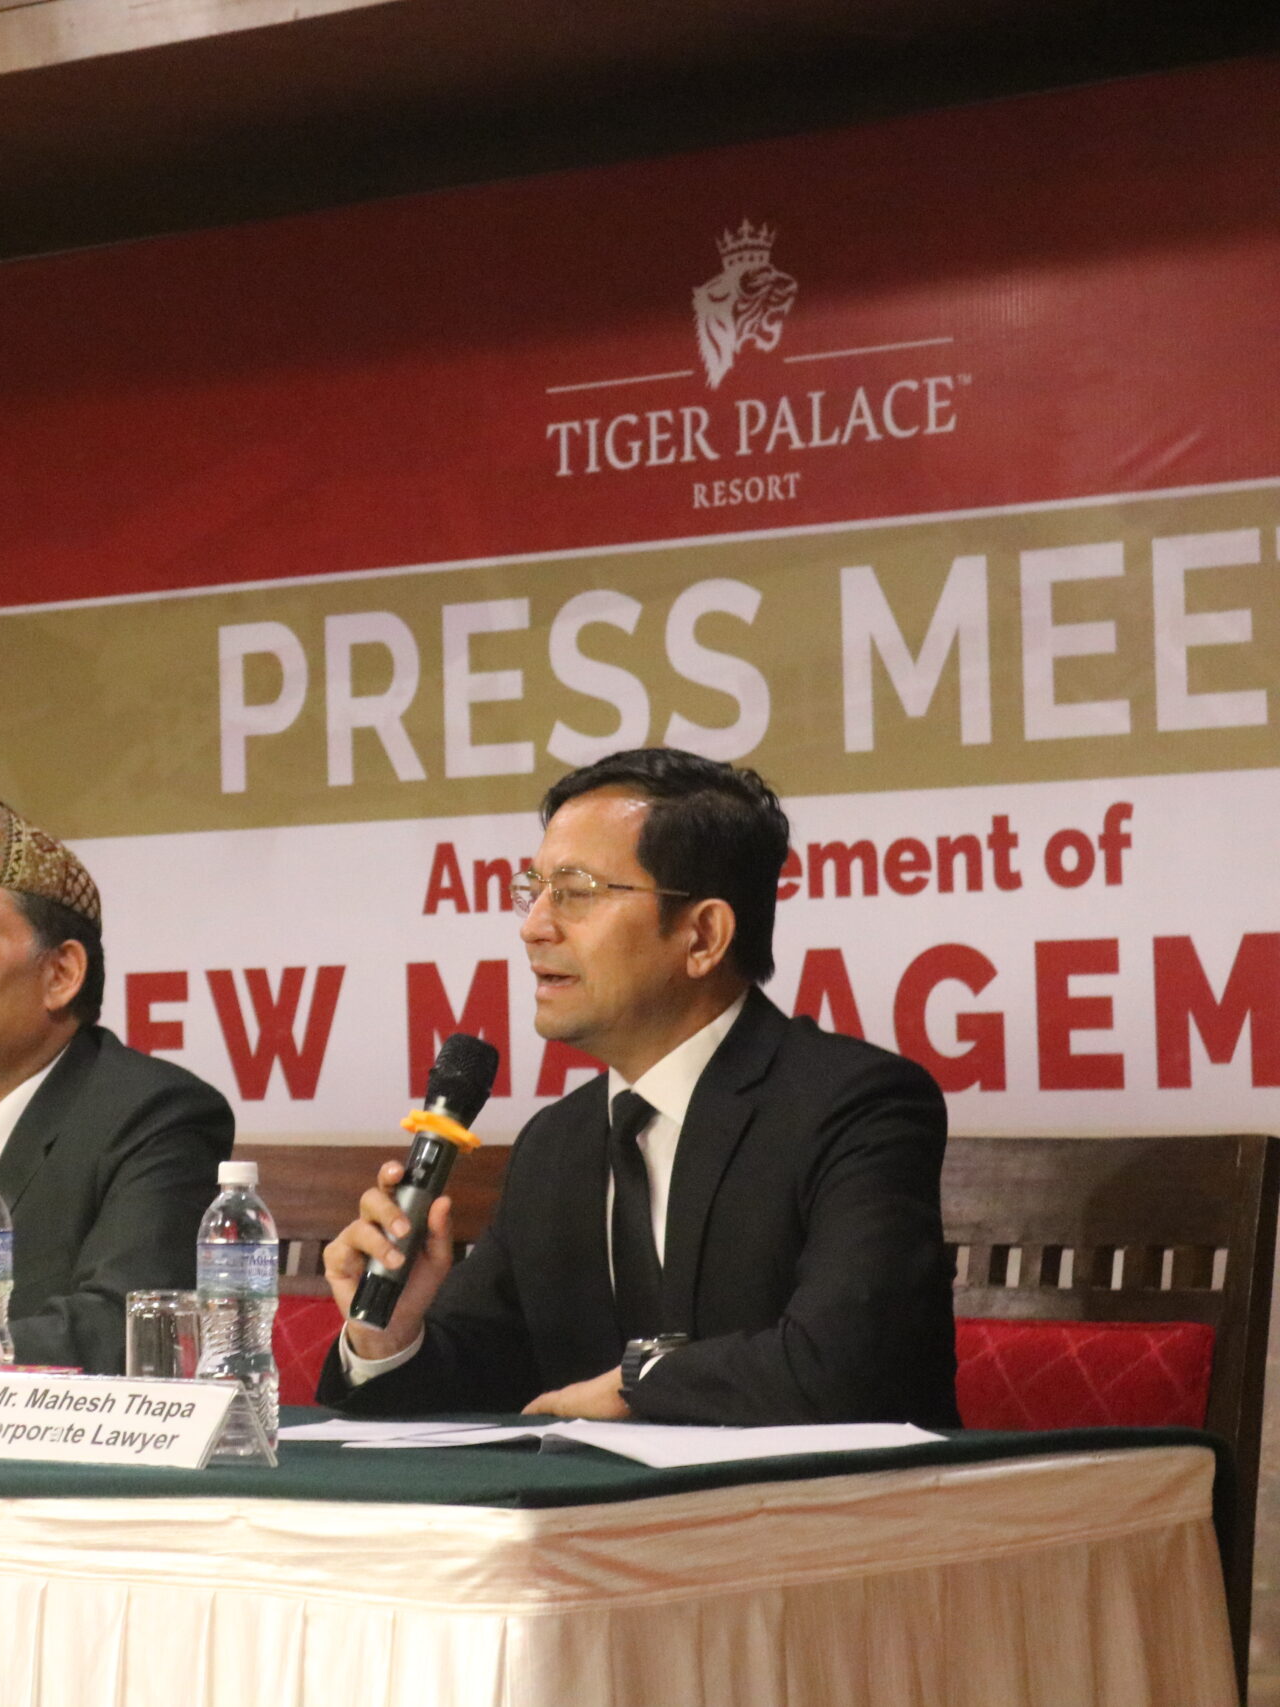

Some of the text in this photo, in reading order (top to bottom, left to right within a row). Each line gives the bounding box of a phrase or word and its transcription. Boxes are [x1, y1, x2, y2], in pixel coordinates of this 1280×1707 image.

[546, 405, 720, 477] TIGER
[692, 472, 801, 509] RESORT
[219, 527, 1280, 794] PRESS MEE
[1044, 802, 1134, 889] of
[125, 930, 1280, 1101] EW MAGEM
[24, 1388, 116, 1413] Mahesh
[123, 1394, 196, 1422] Thapa
[90, 1424, 180, 1454] Lawyer
